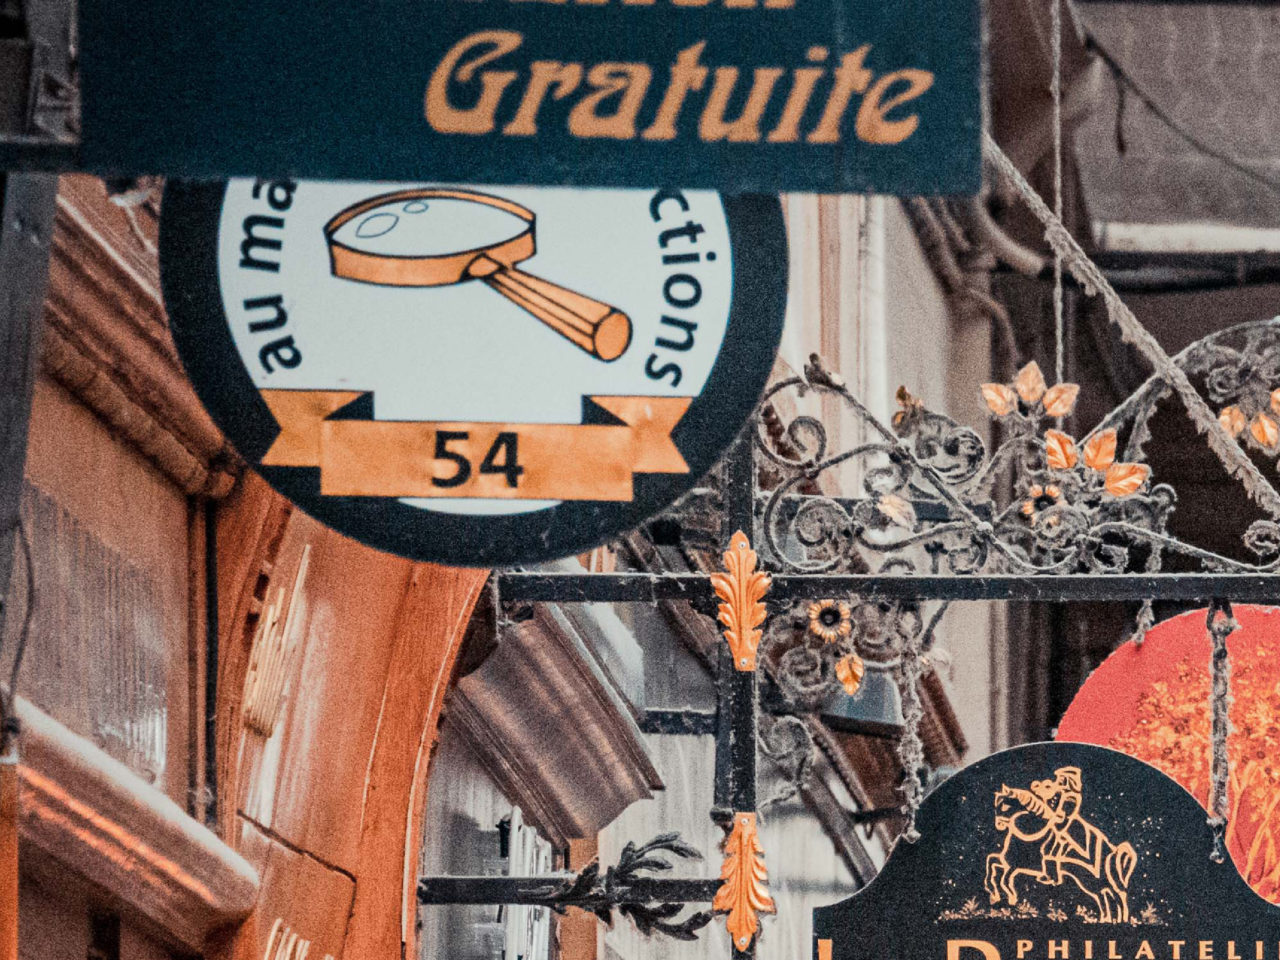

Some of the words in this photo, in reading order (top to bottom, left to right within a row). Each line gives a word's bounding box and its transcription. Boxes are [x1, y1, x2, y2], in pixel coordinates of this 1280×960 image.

[425, 30, 934, 144] Gratuite
[243, 294, 302, 374] au
[645, 185, 717, 388] ctions
[431, 431, 523, 489] 54
